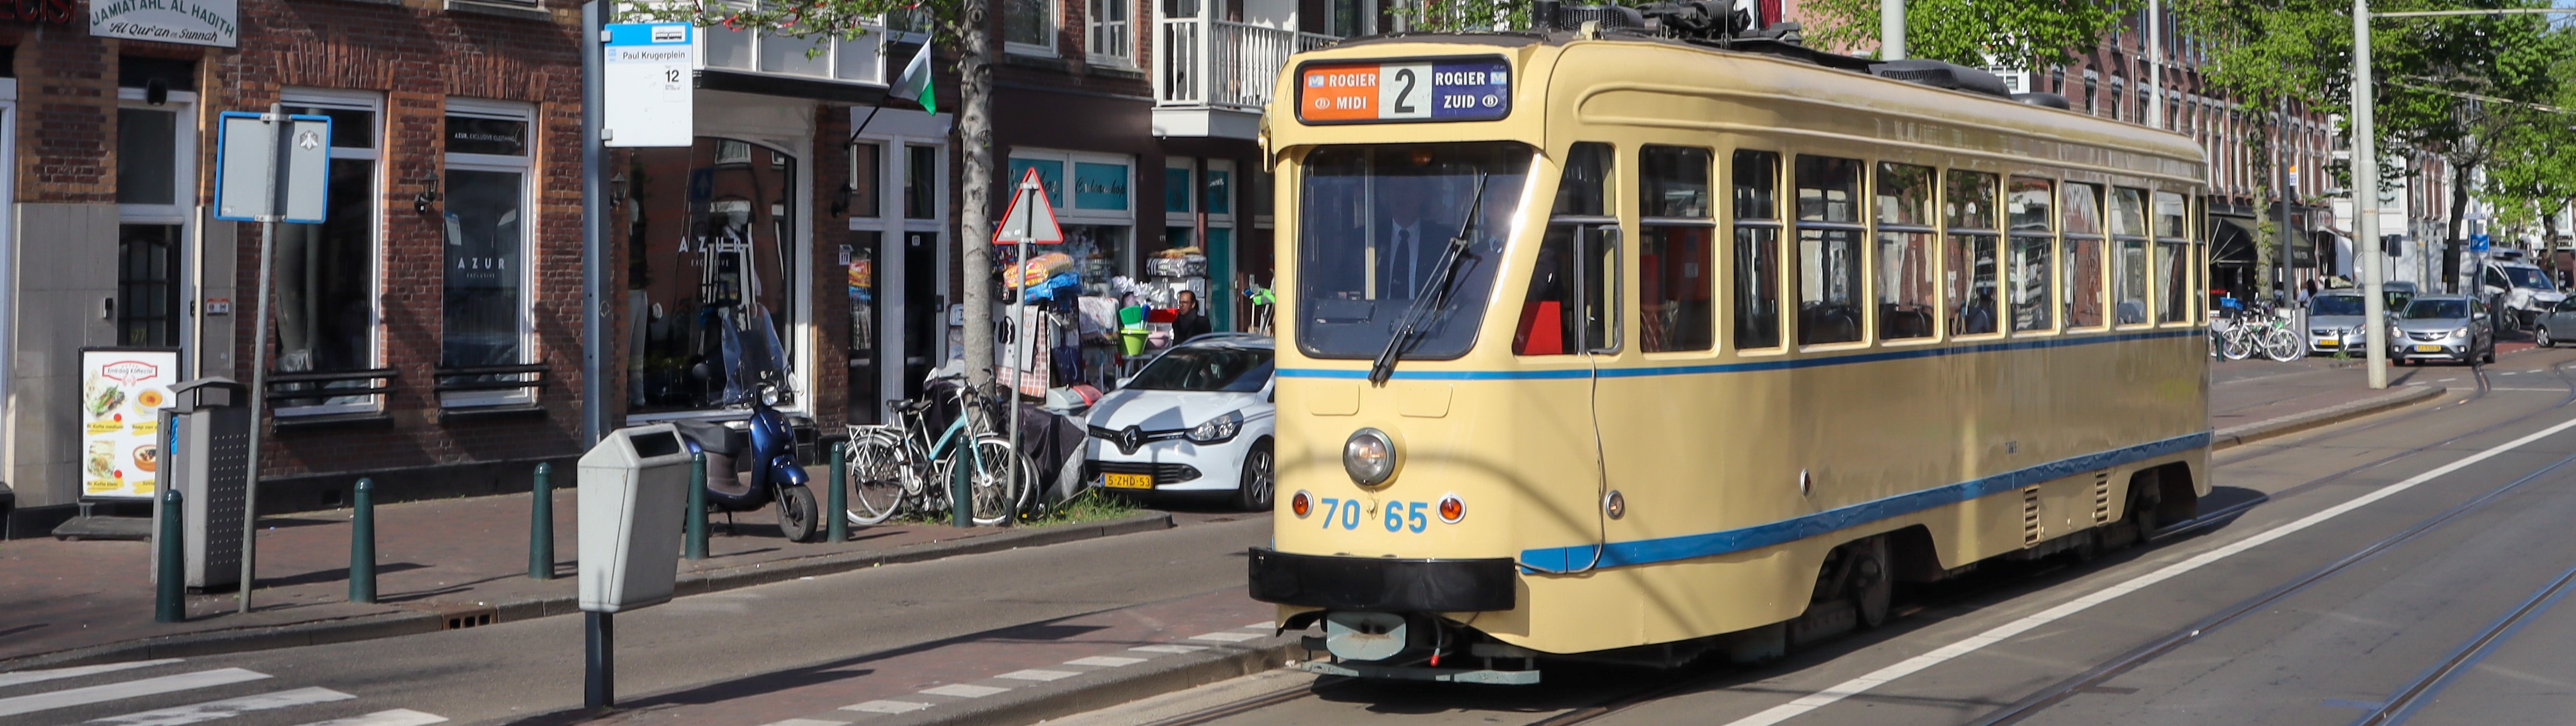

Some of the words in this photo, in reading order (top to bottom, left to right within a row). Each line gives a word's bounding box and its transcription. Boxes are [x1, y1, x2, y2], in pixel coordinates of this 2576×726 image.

[93, 0, 136, 26] JAMIAT
[140, 0, 166, 10] AHL
[171, 0, 187, 14] AL
[191, 4, 234, 38] HADITH
[179, 28, 217, 43] Sunnah
[623, 51, 639, 60] Paul
[642, 51, 685, 61] Krugerplein
[665, 70, 679, 83] 12
[1330, 73, 1376, 87] ROGIER
[1435, 71, 1485, 86] ROGIER
[1394, 69, 1416, 113] 2
[1337, 96, 1367, 110] MIDI
[1444, 94, 1476, 109] ZUID
[678, 236, 742, 253] AZUR
[458, 257, 505, 270] AZUR
[691, 259, 729, 267] EXCSIVE
[1108, 475, 1150, 487] 5-ZHD-53
[1321, 498, 1360, 531] 70
[1384, 500, 1428, 533] 65
